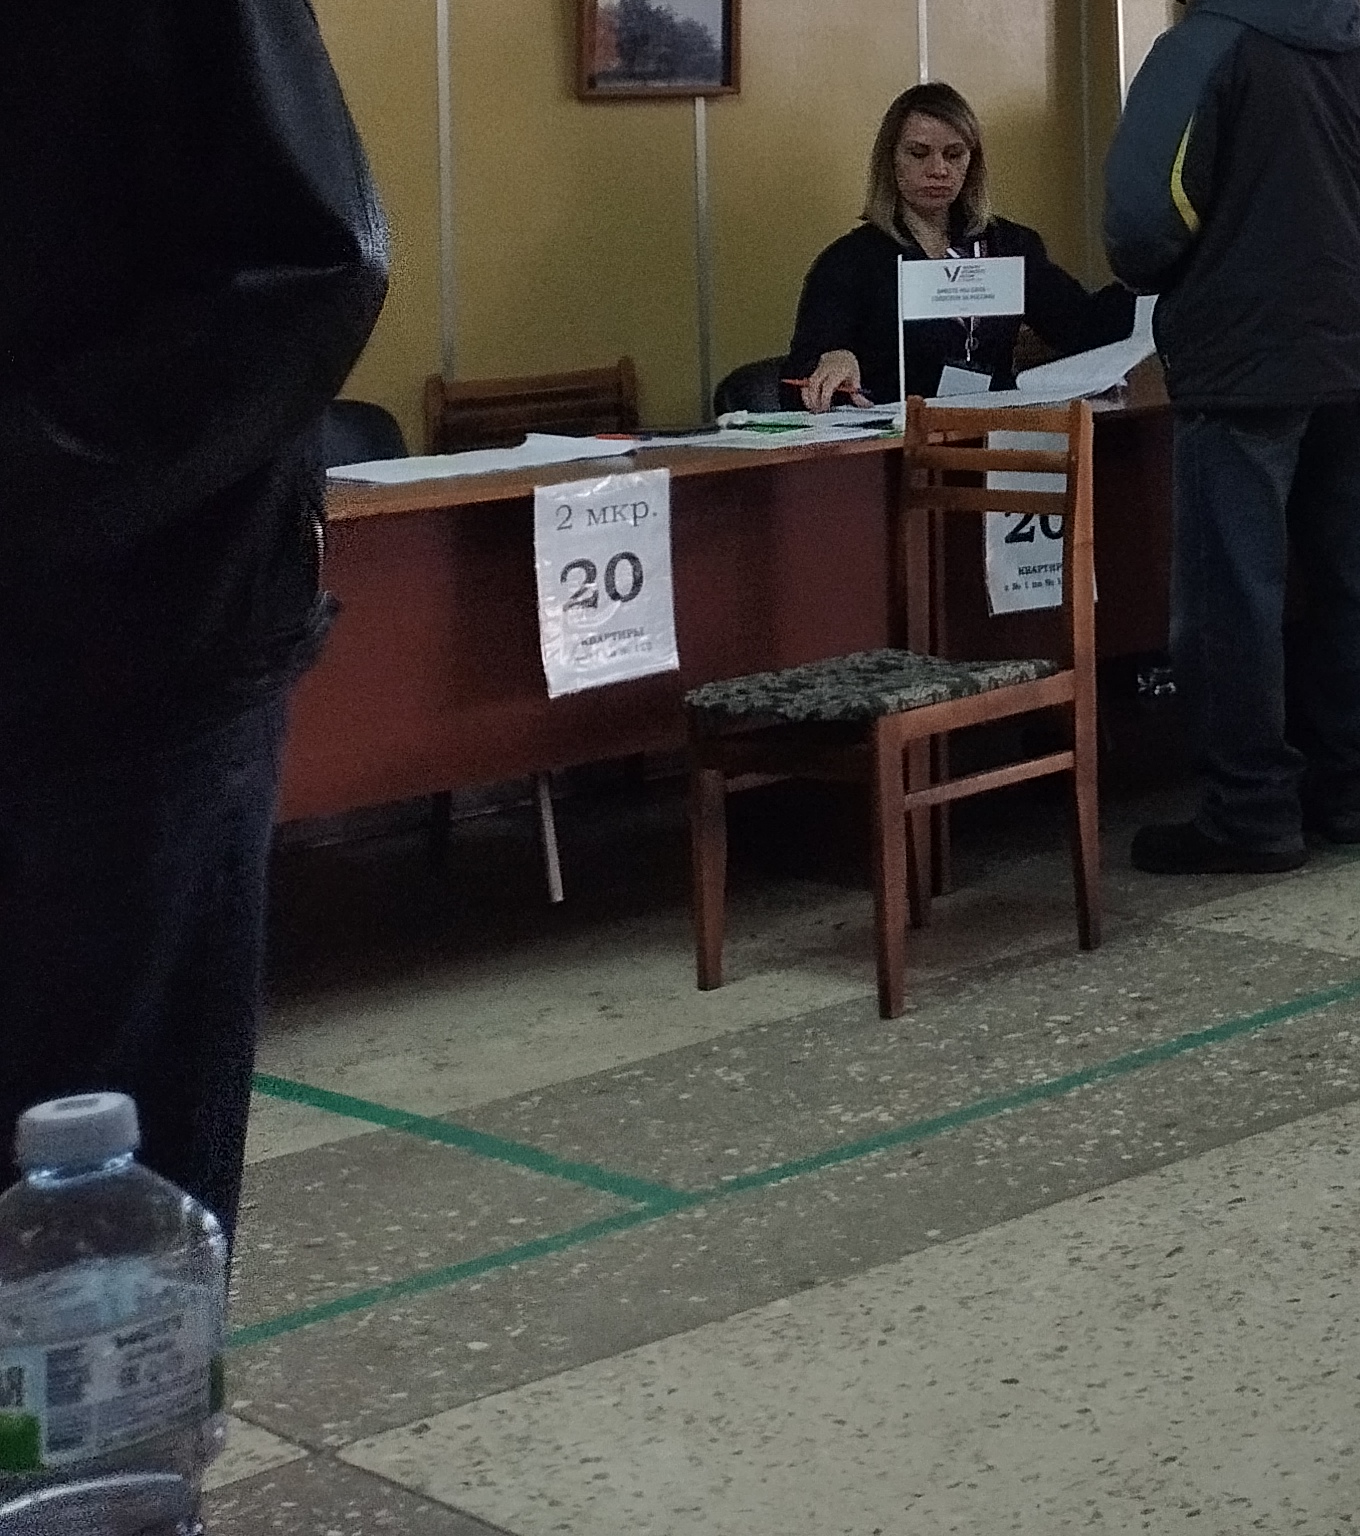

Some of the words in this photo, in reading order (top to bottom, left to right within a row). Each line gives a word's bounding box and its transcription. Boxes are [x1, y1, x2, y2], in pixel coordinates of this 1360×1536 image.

[555, 504, 573, 531] 2
[586, 500, 658, 527] мкр.
[1004, 512, 1063, 544] 20
[560, 551, 644, 612] 20
[1018, 562, 1062, 575] КВАРТИР
